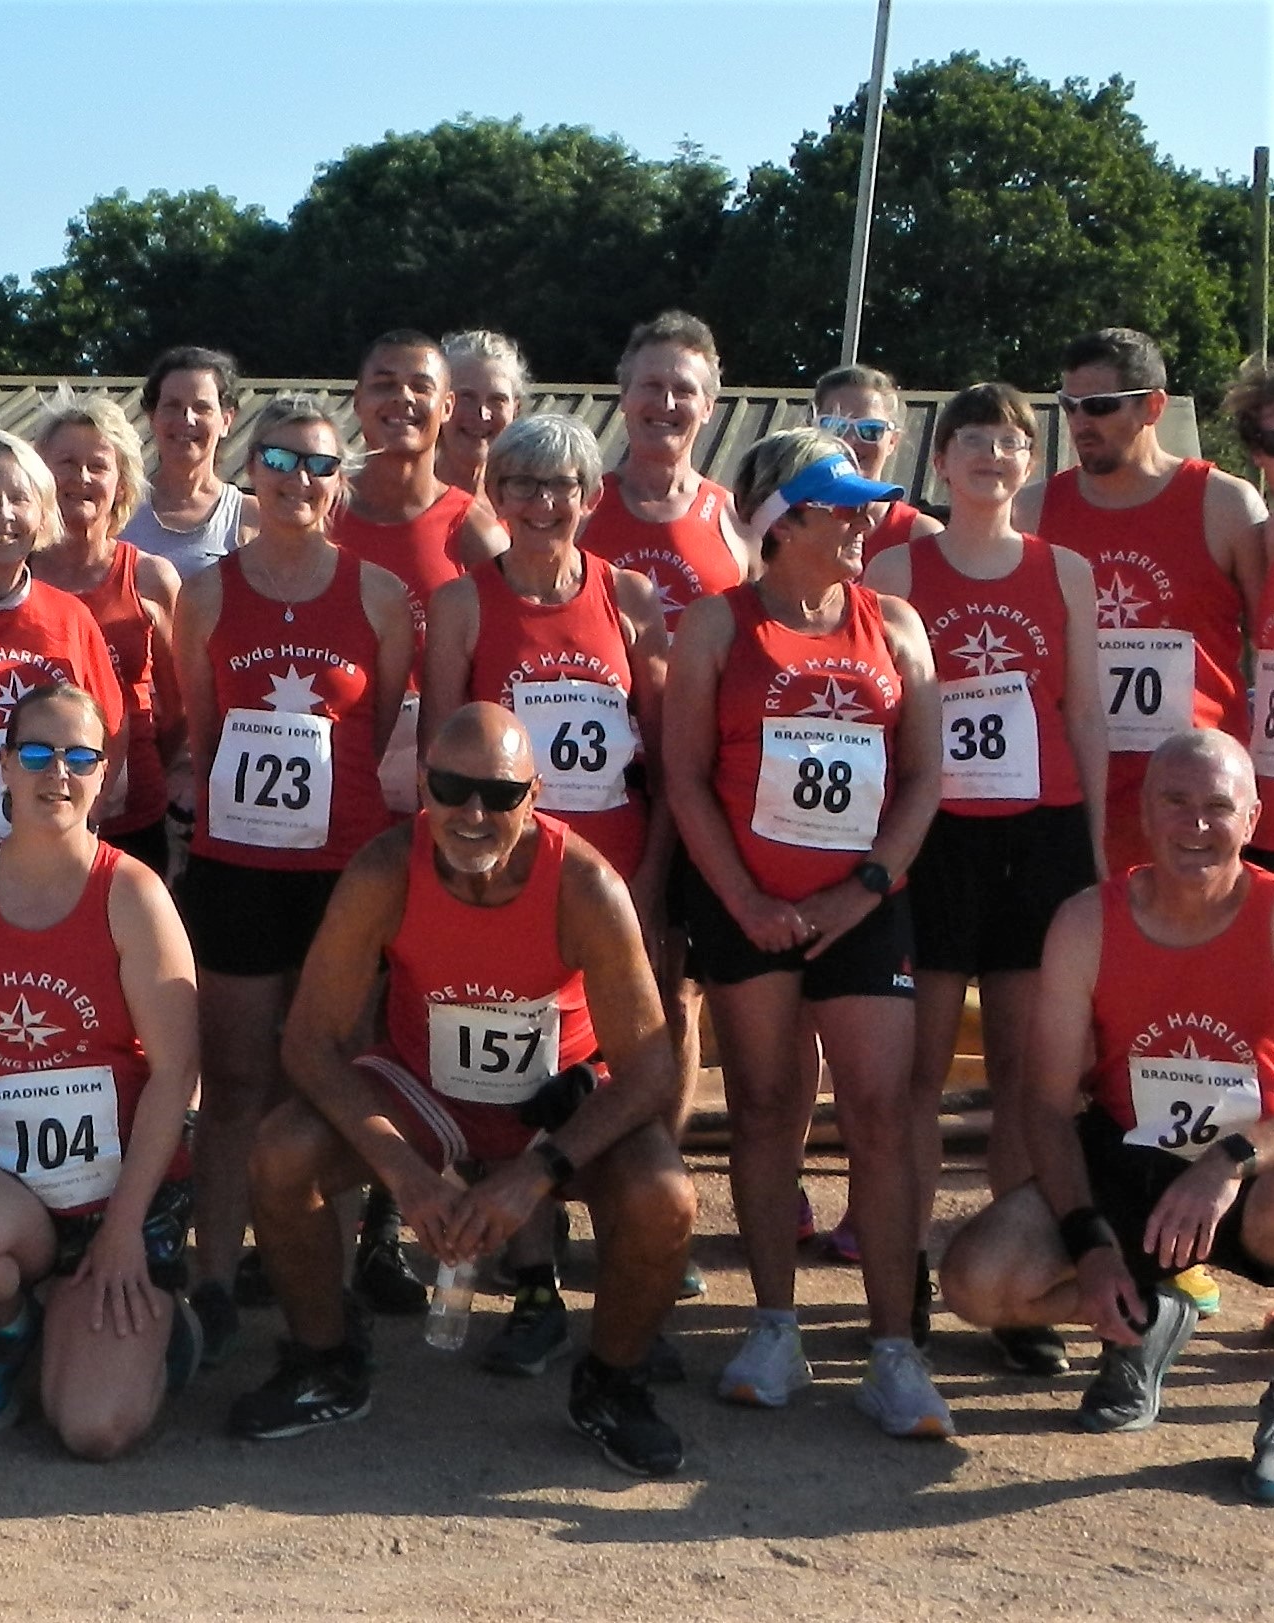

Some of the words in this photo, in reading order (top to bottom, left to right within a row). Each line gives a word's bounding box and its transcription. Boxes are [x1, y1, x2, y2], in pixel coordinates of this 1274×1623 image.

[613, 552, 634, 568] DE
[638, 548, 703, 594] HARRIERS
[1100, 550, 1173, 600] HARRIERS
[928, 608, 961, 636] YDE
[966, 603, 1049, 656] HARRIERS
[1151, 641, 1182, 650] 10KM
[229, 647, 274, 671] Ryde
[280, 644, 357, 675] Harriers
[540, 651, 622, 690] HARRIE
[524, 693, 587, 706] BRADING
[766, 663, 802, 710] RYDE
[805, 657, 896, 710] HARRIERS
[942, 689, 985, 703] ADING
[989, 683, 1023, 696] 10KM
[1109, 667, 1162, 715] 70
[231, 722, 283, 736] BRADING
[288, 727, 322, 739] 10KM
[550, 720, 608, 773] 63
[774, 730, 835, 742] BRADING
[838, 733, 871, 746] 10KM
[949, 713, 1006, 761] 38
[234, 751, 312, 811] 123
[793, 757, 853, 814] 88
[3, 971, 100, 1030] HARRIERS
[430, 985, 458, 1001] DE
[26, 1050, 72, 1070] SINCE
[459, 1025, 542, 1074] 157
[1129, 1022, 1163, 1053] YDE
[66, 1082, 102, 1095] 10KM
[1141, 1069, 1204, 1085] BRADING
[1208, 1076, 1244, 1087] 10KM
[15, 1114, 99, 1174] 104
[1158, 1101, 1221, 1149] 36
